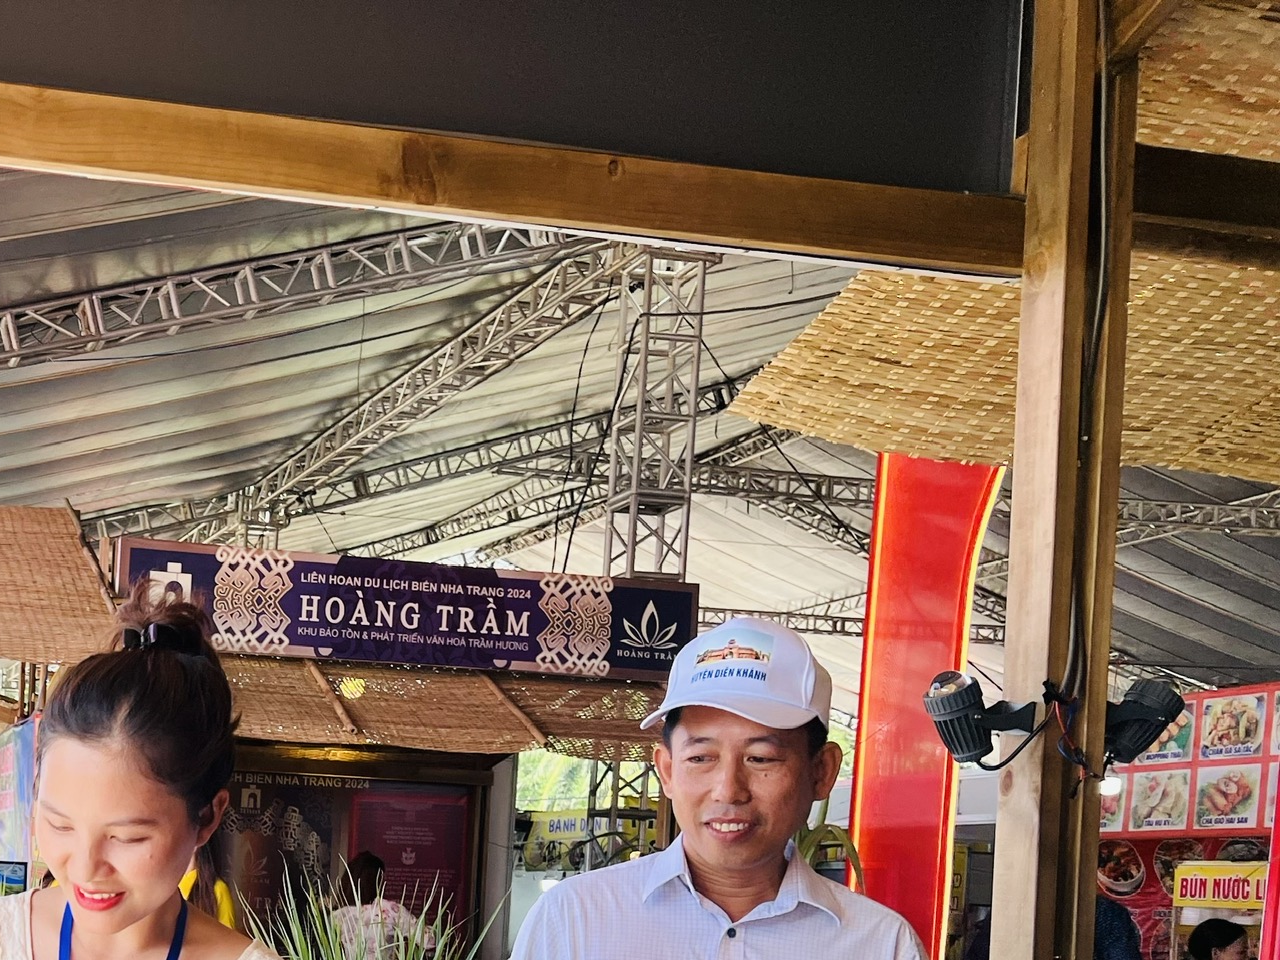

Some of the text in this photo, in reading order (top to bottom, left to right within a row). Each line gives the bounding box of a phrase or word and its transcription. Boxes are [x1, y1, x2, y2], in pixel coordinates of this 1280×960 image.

[300, 571, 326, 584] LIÊN
[329, 575, 362, 587] HOAN
[365, 577, 380, 588] DU
[382, 579, 409, 592] LỊCH
[440, 583, 464, 595] NHA
[466, 585, 505, 597] TRANG
[507, 588, 531, 599] 2024
[299, 590, 531, 637] HOÀNG TRẦM
[297, 626, 317, 637] KHU
[362, 631, 369, 640] &
[370, 630, 394, 642] PHÁT
[617, 648, 651, 660] HOÀNG
[736, 667, 767, 681] KHÁNH
[275, 775, 300, 786] NHA
[303, 776, 342, 788] TRANG
[345, 779, 370, 789] 2024
[1180, 873, 1208, 899] BÚN
[1212, 874, 1250, 900] NƯỚC
